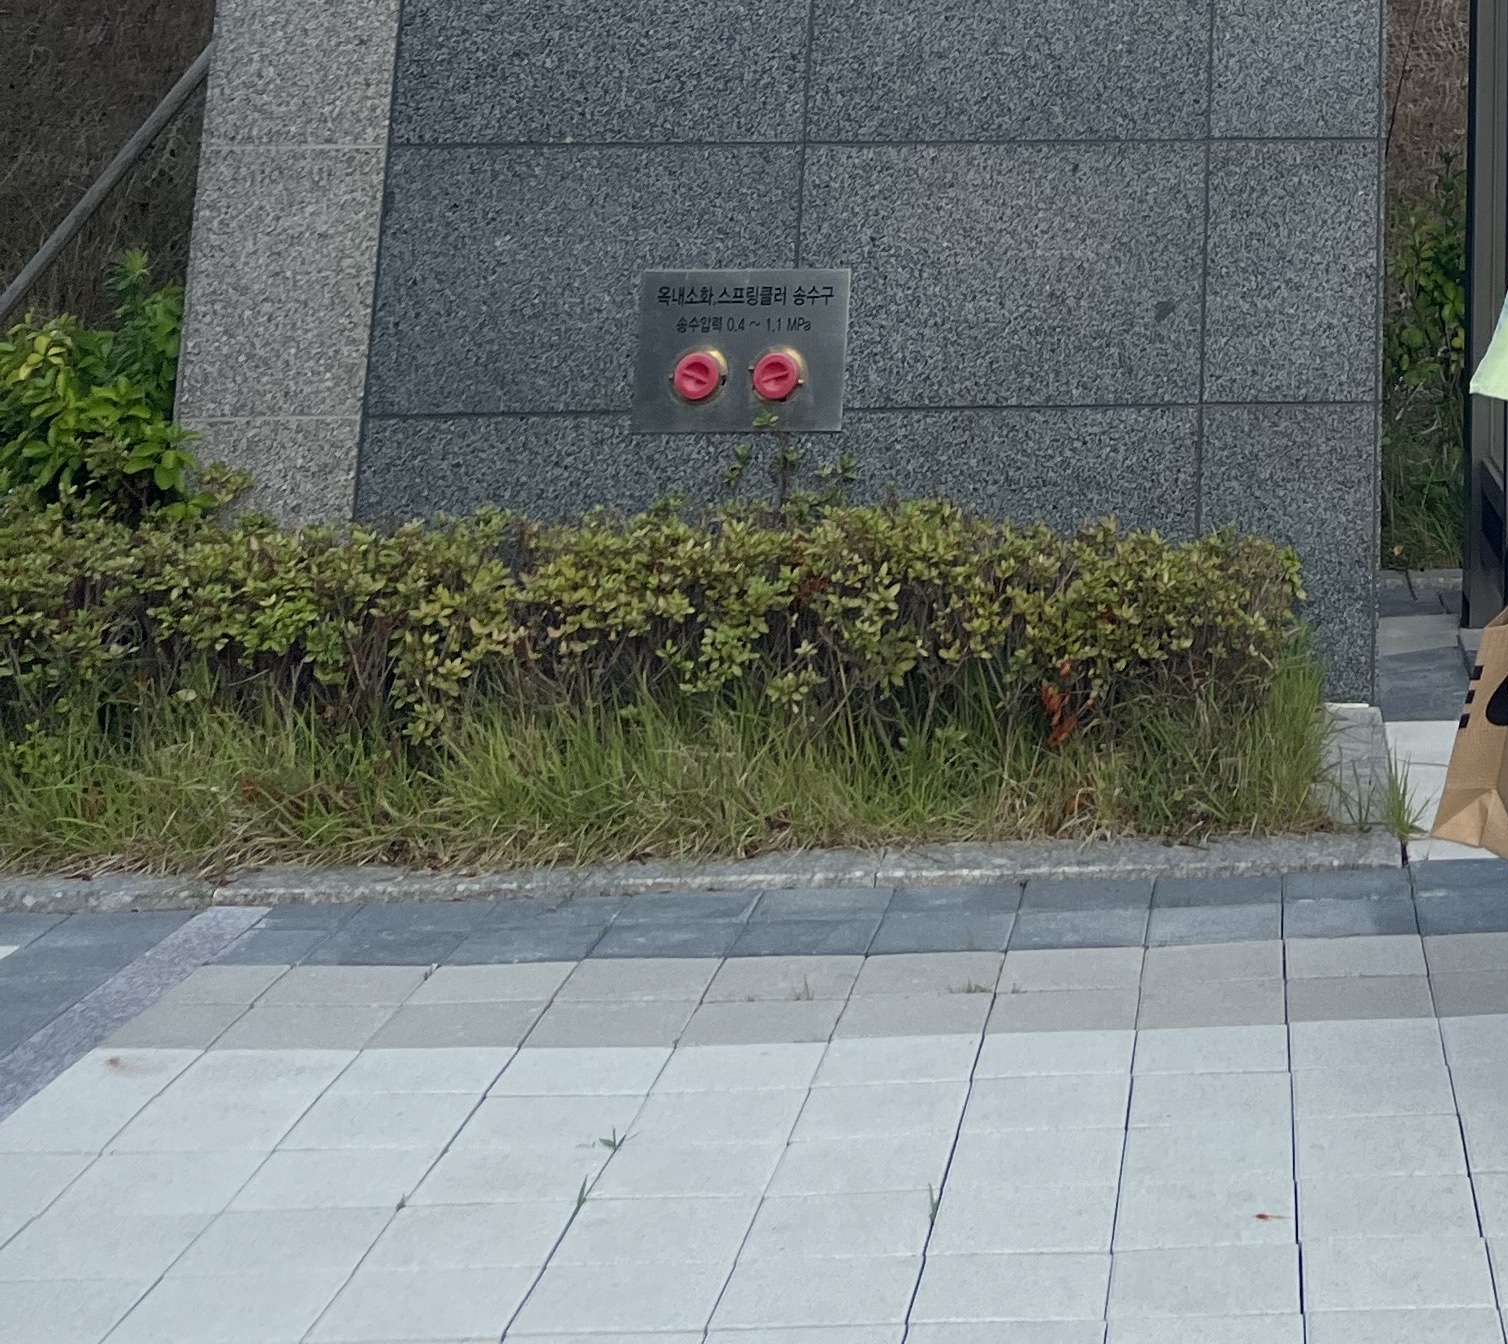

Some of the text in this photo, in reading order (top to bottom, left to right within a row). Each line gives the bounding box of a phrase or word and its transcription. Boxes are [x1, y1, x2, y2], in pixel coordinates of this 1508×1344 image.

[793, 285, 834, 306] 송수구
[676, 316, 723, 333] 송수압력
[726, 316, 745, 332] 0.4
[766, 316, 782, 332] 1.1
[787, 316, 811, 332] MPa
